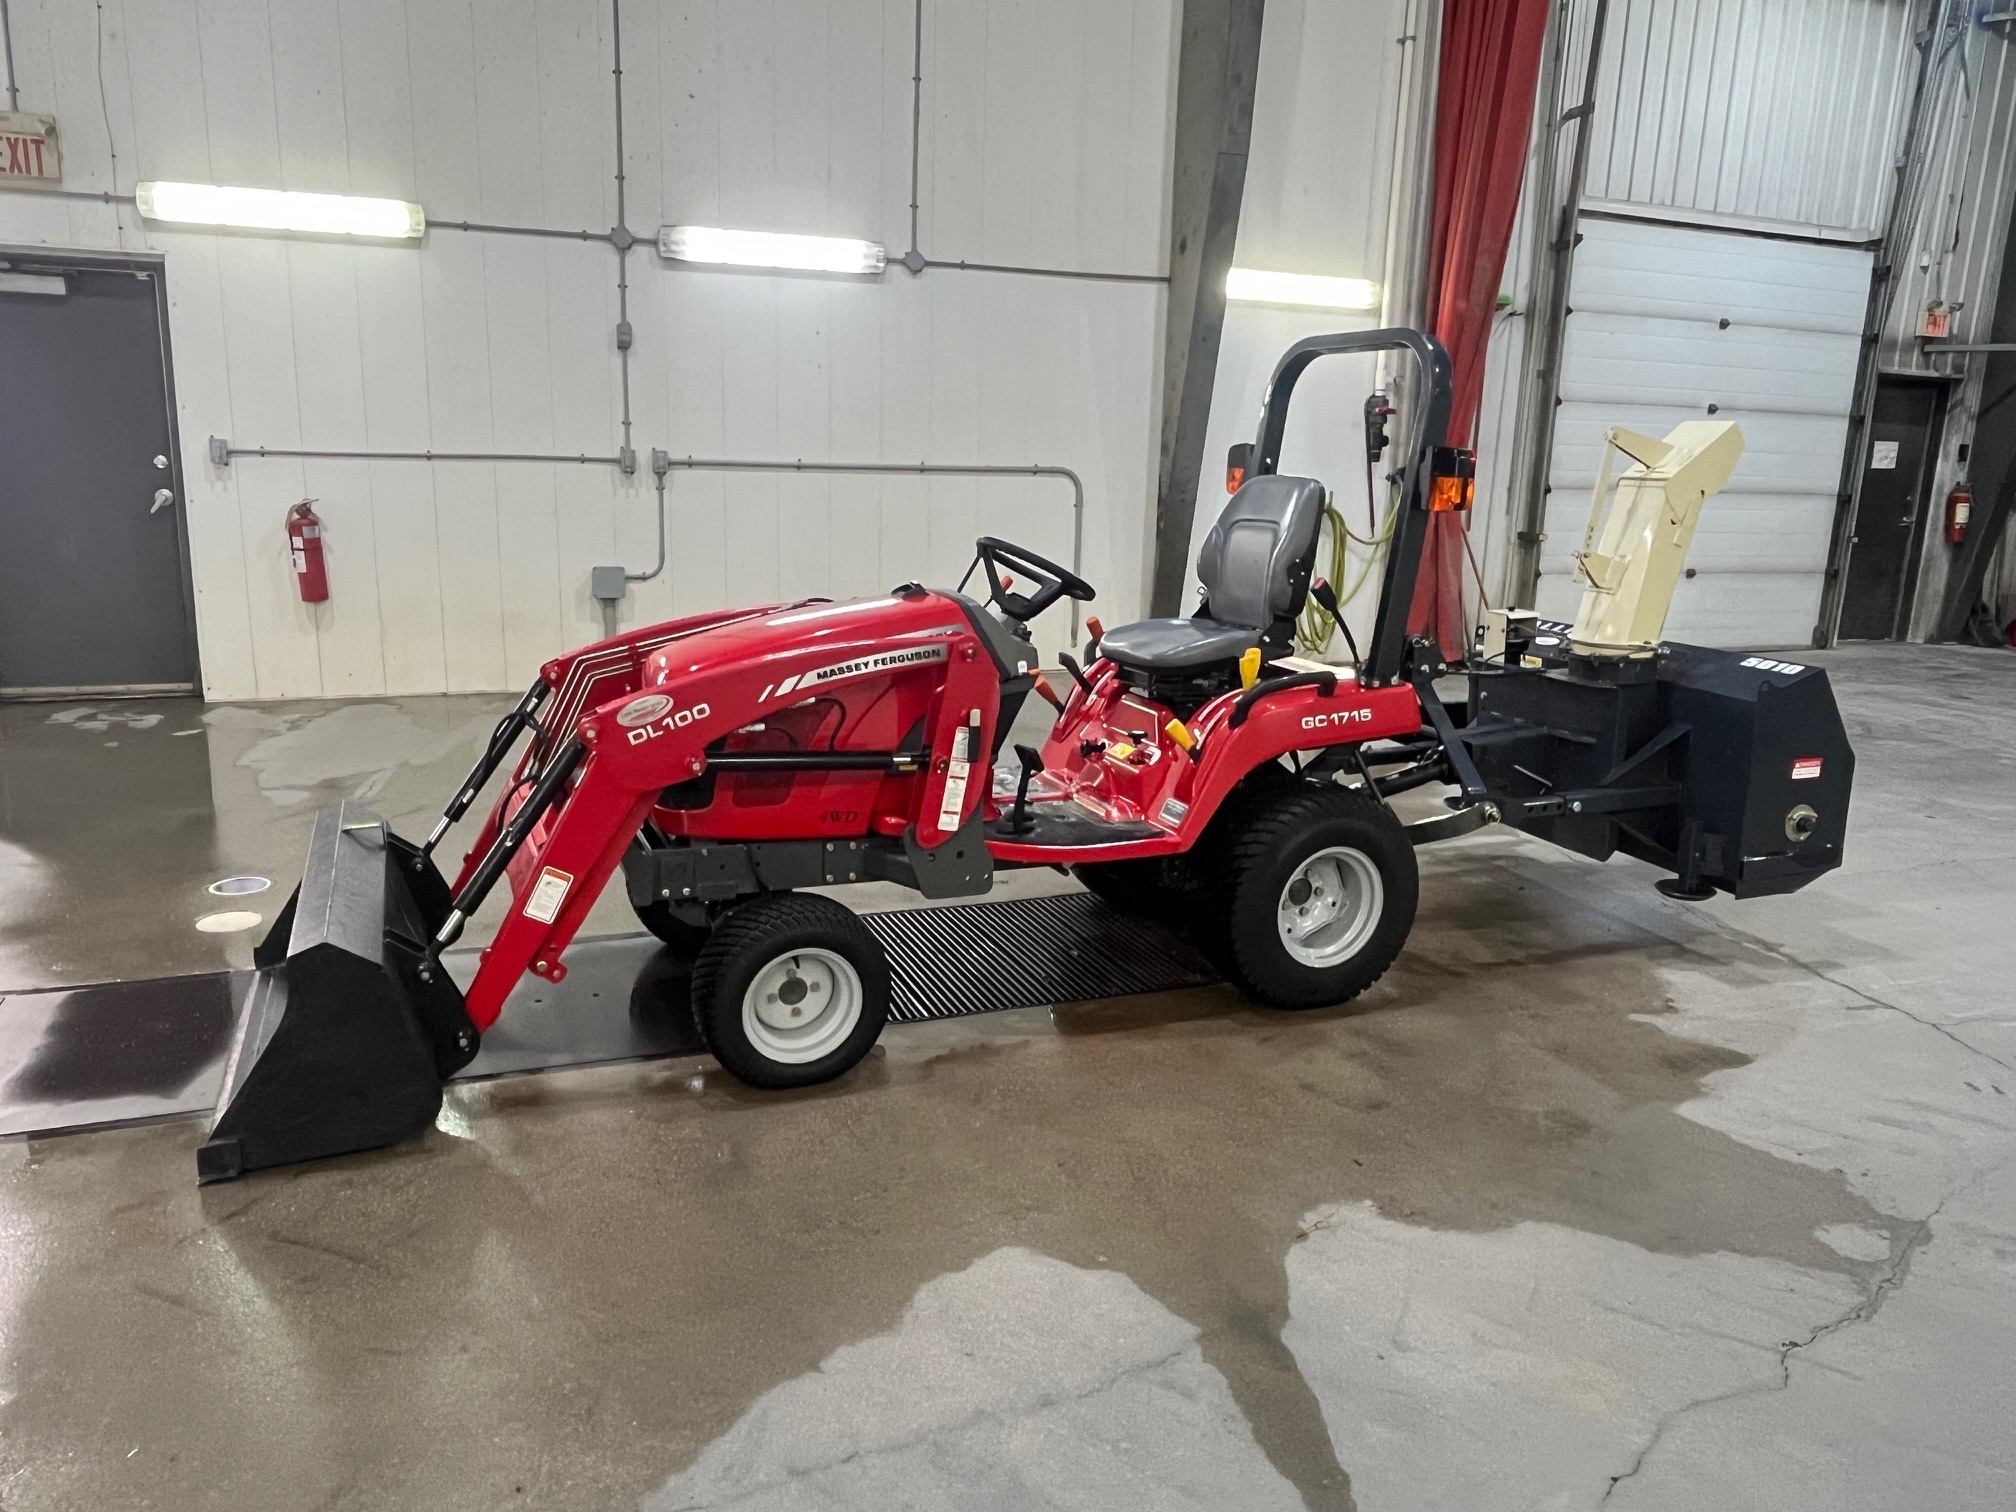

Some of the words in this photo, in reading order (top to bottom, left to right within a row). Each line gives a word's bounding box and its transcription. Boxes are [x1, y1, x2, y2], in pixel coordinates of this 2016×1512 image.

[816, 660, 870, 680] MASSEY
[873, 648, 941, 668] FERGUSON
[1740, 657, 1806, 675] 5010
[626, 702, 711, 746] DL100
